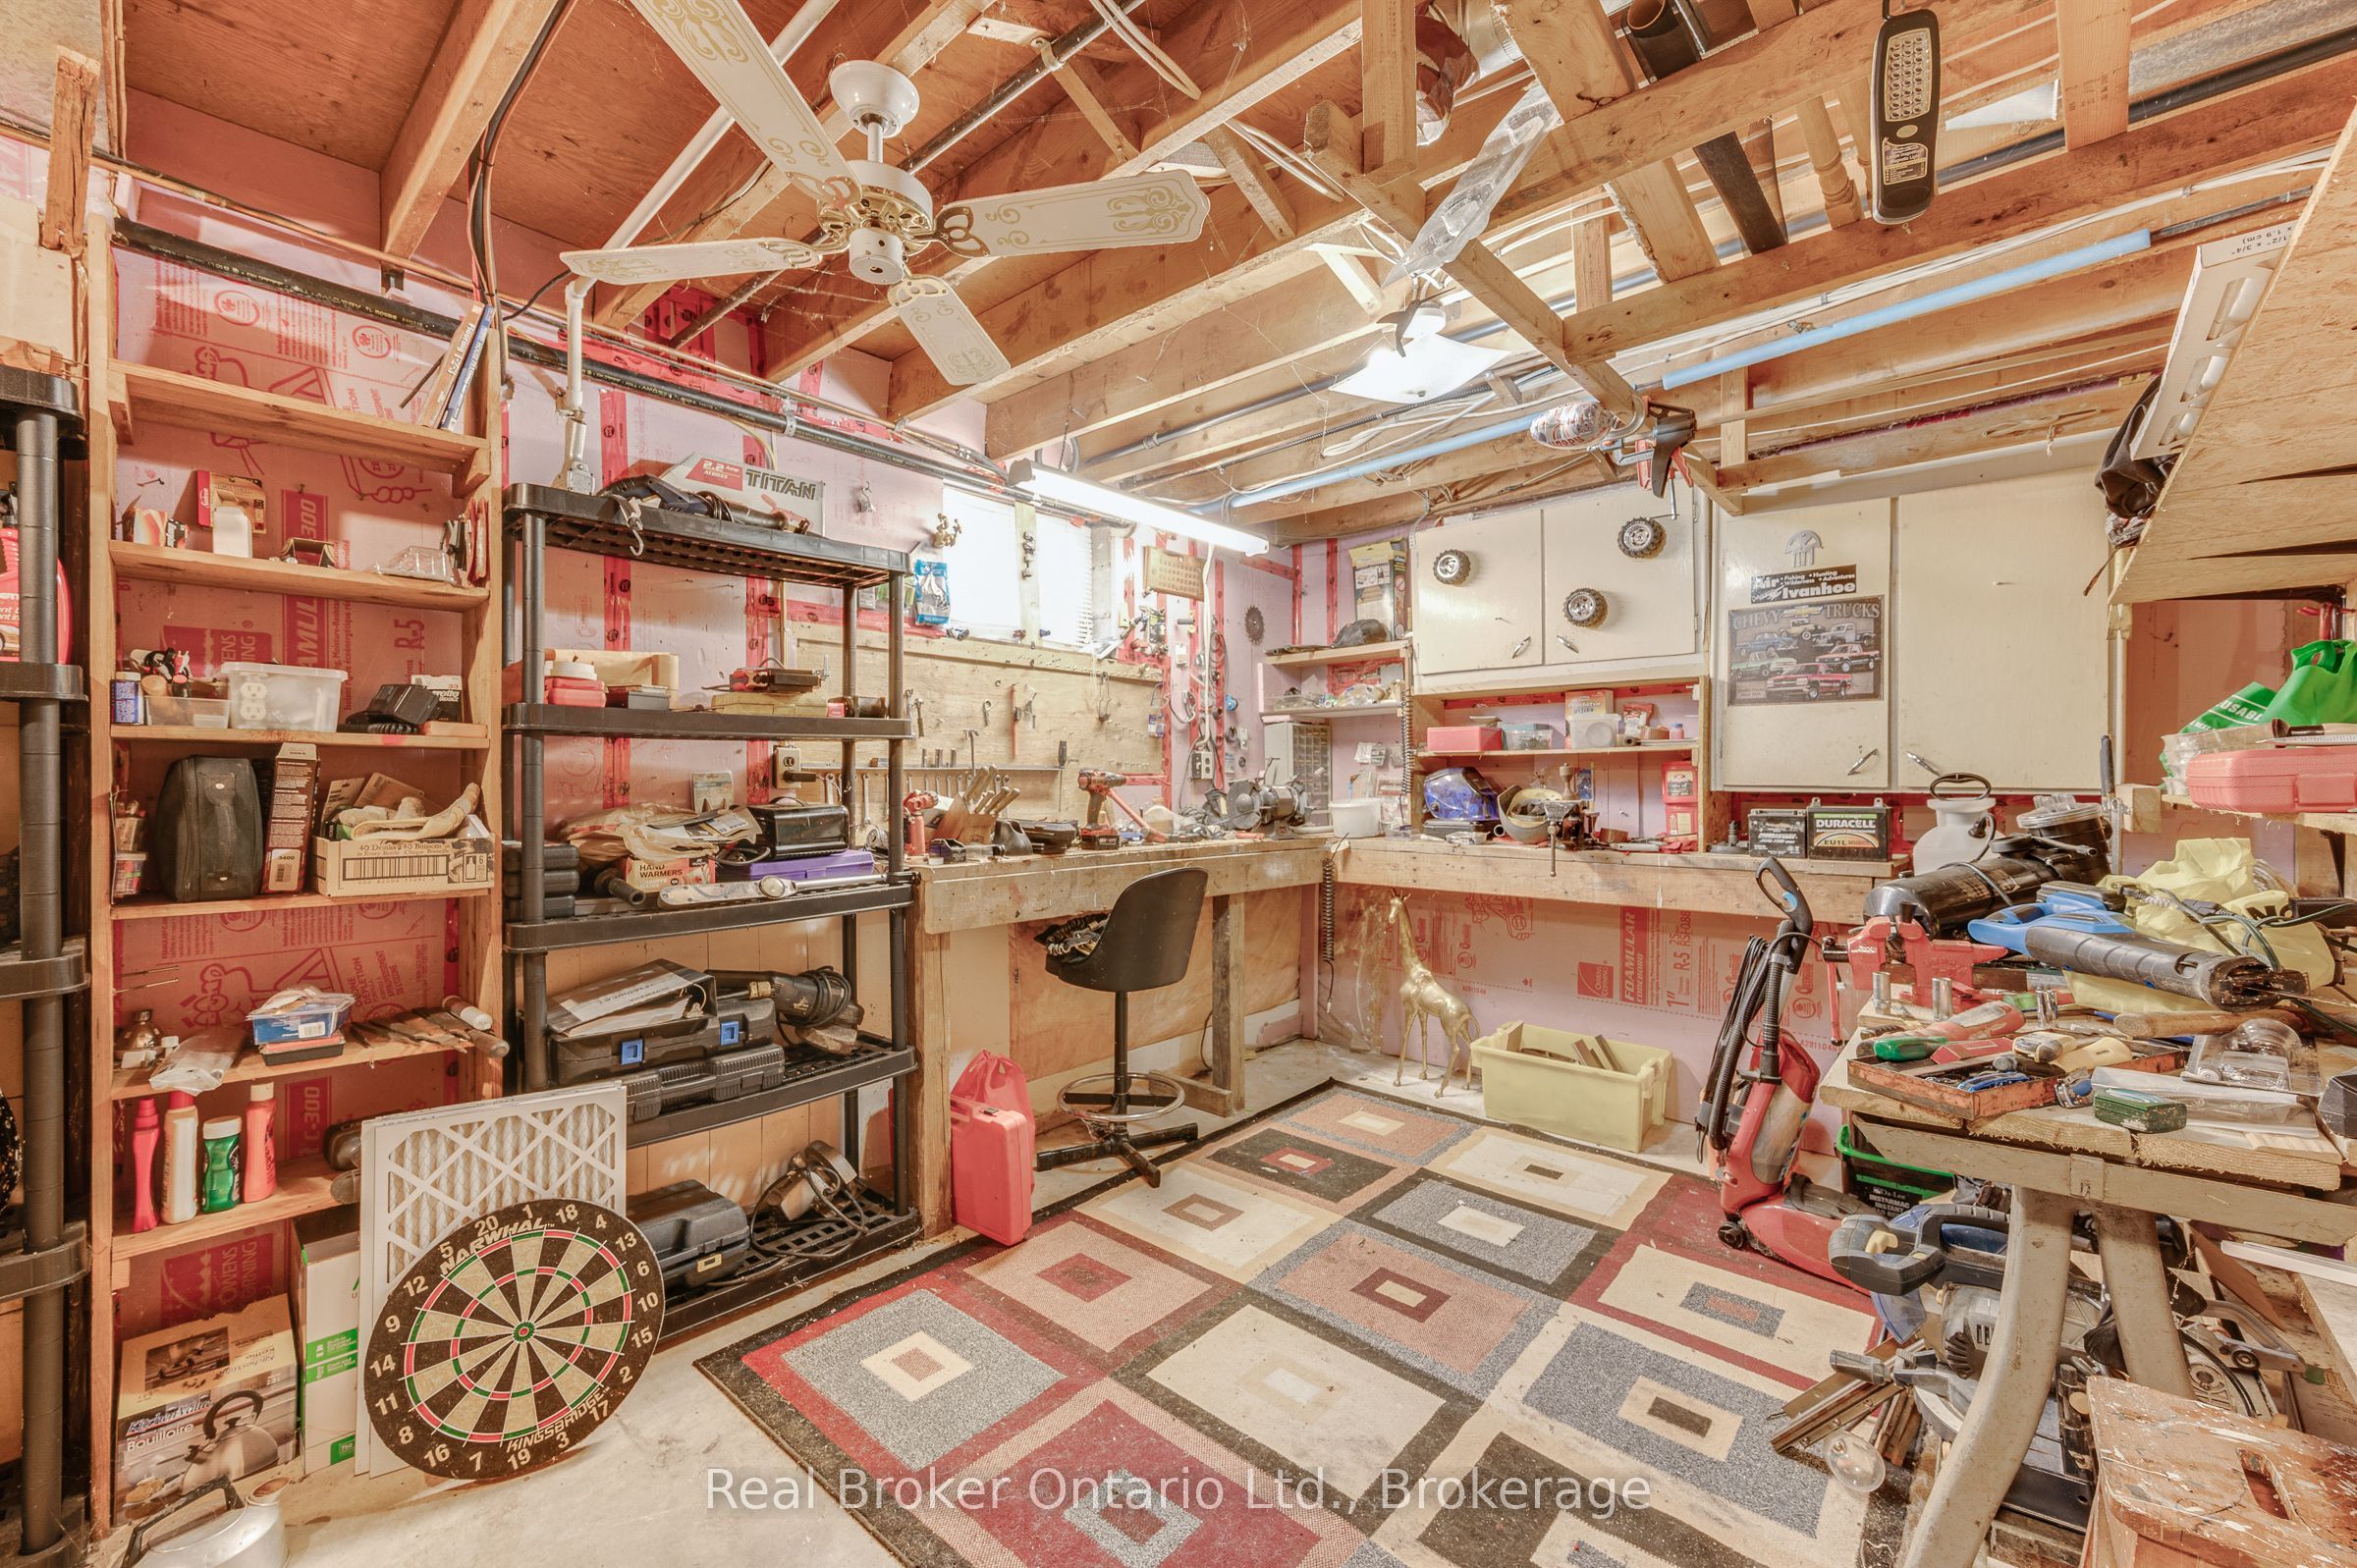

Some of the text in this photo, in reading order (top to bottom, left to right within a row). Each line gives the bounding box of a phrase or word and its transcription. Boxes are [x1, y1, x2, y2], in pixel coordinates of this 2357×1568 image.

[2231, 244, 2252, 255] 3/4"
[2242, 235, 2262, 243] cm)
[703, 460, 725, 471] 2.2
[746, 468, 816, 500] TITAN
[1813, 569, 1837, 578] Hunting
[1823, 572, 1855, 581] Adventures
[1781, 582, 1855, 599] Ivanhoe
[1733, 603, 1880, 630] CHEVY TRUCKS
[394, 619, 424, 650] R-5
[2220, 699, 2264, 722] USABL
[1816, 819, 1877, 829] DURACELL
[478, 856, 484, 865] 6
[639, 869, 683, 878] WARMERS
[1624, 912, 1635, 1001] FOAMULAR
[1673, 951, 1690, 971] R-5
[352, 956, 372, 1005] DEPLETION
[522, 1205, 533, 1218] 1
[1869, 1194, 1910, 1209] INSTARMAC
[555, 1204, 578, 1224] 18
[595, 1214, 608, 1230] 4
[474, 1215, 500, 1237] 20
[437, 1241, 454, 1258] 5
[440, 1217, 545, 1276] NARWHAL
[615, 1231, 637, 1253] 13
[219, 1246, 239, 1305] OWENS
[636, 1261, 650, 1276] 6
[403, 1275, 429, 1298] 12
[637, 1291, 659, 1312] 10
[385, 1315, 401, 1332] 9
[631, 1326, 653, 1348] 15
[369, 1354, 397, 1378] 14
[619, 1366, 633, 1384] 2
[374, 1394, 400, 1416] 11
[588, 1400, 609, 1423] 17
[506, 1390, 605, 1453] KINGSBRIDGE
[127, 1423, 194, 1452] Bouilloire
[398, 1426, 414, 1444] 8
[556, 1431, 570, 1449] 3
[423, 1443, 451, 1468] 16
[468, 1451, 484, 1472] 7
[507, 1447, 531, 1470] 19
